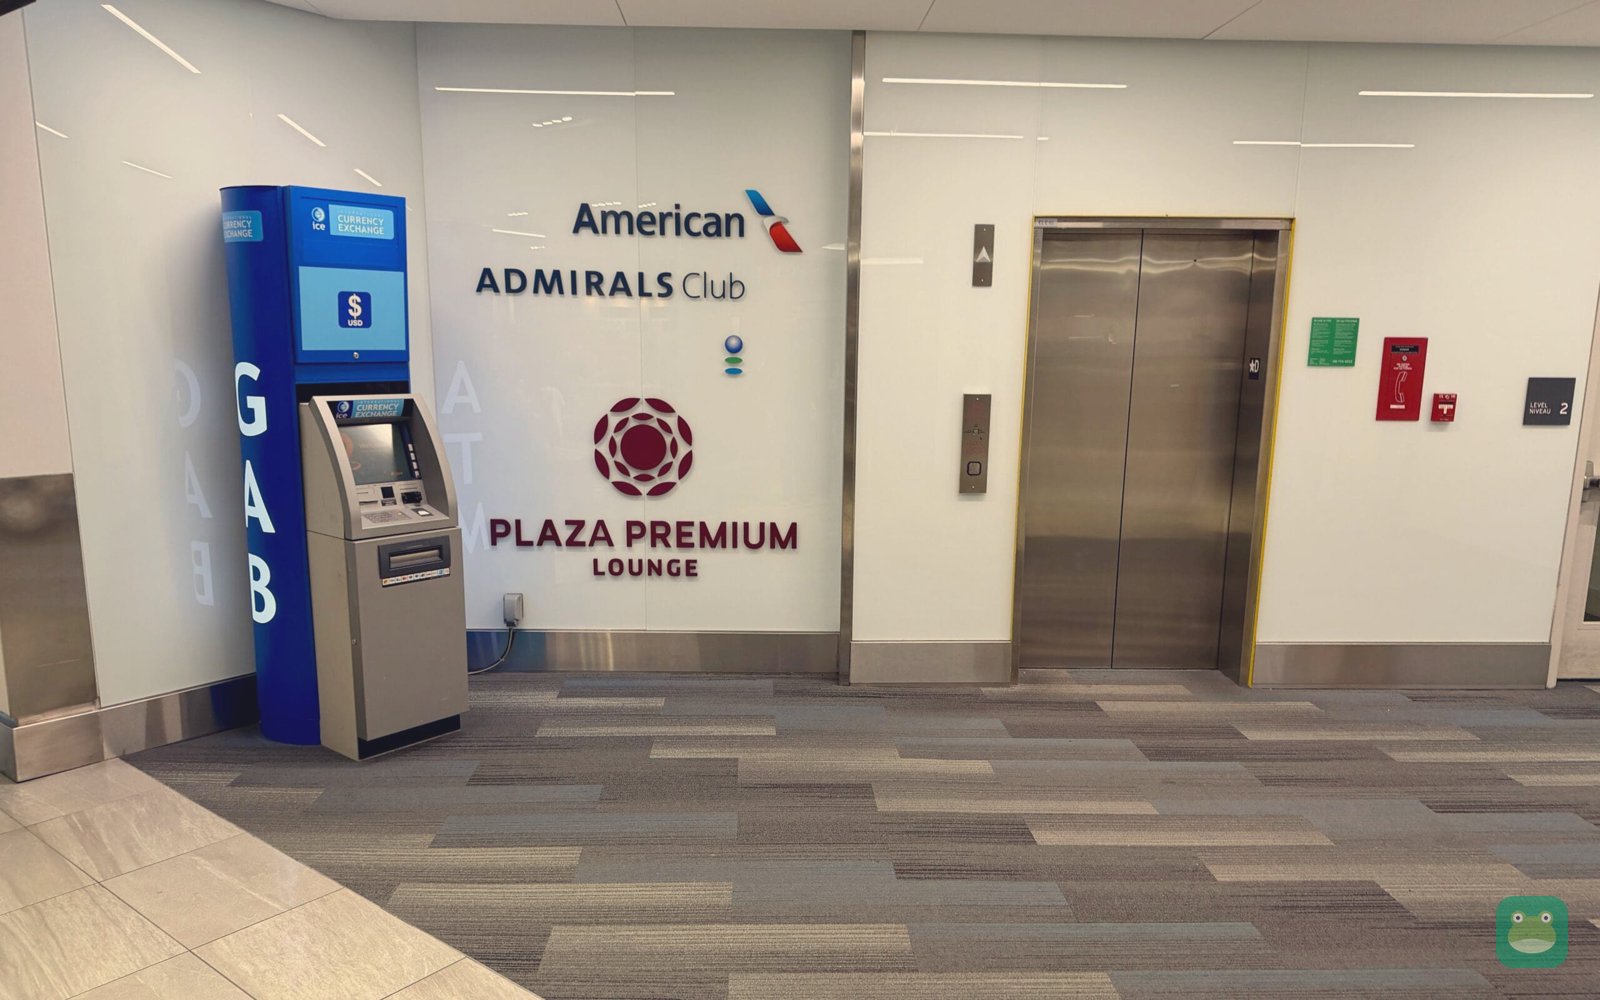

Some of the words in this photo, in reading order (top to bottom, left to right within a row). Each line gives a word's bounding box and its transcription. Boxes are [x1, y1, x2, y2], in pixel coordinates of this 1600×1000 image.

[337, 214, 384, 226] CURRENCY
[572, 203, 745, 238] American
[312, 222, 326, 231] ice
[338, 223, 385, 235] EXCHANGE
[475, 267, 674, 298] ADMIRALS
[682, 271, 745, 299] Club
[347, 293, 362, 319] $
[347, 319, 363, 327] USD
[356, 403, 400, 411] CURRENCY
[1559, 402, 1569, 415] 2
[355, 410, 398, 418] EXCHANGE
[490, 519, 614, 547] PLAZA
[626, 520, 798, 549] PREMIUM
[593, 558, 699, 577] LOUNGE
